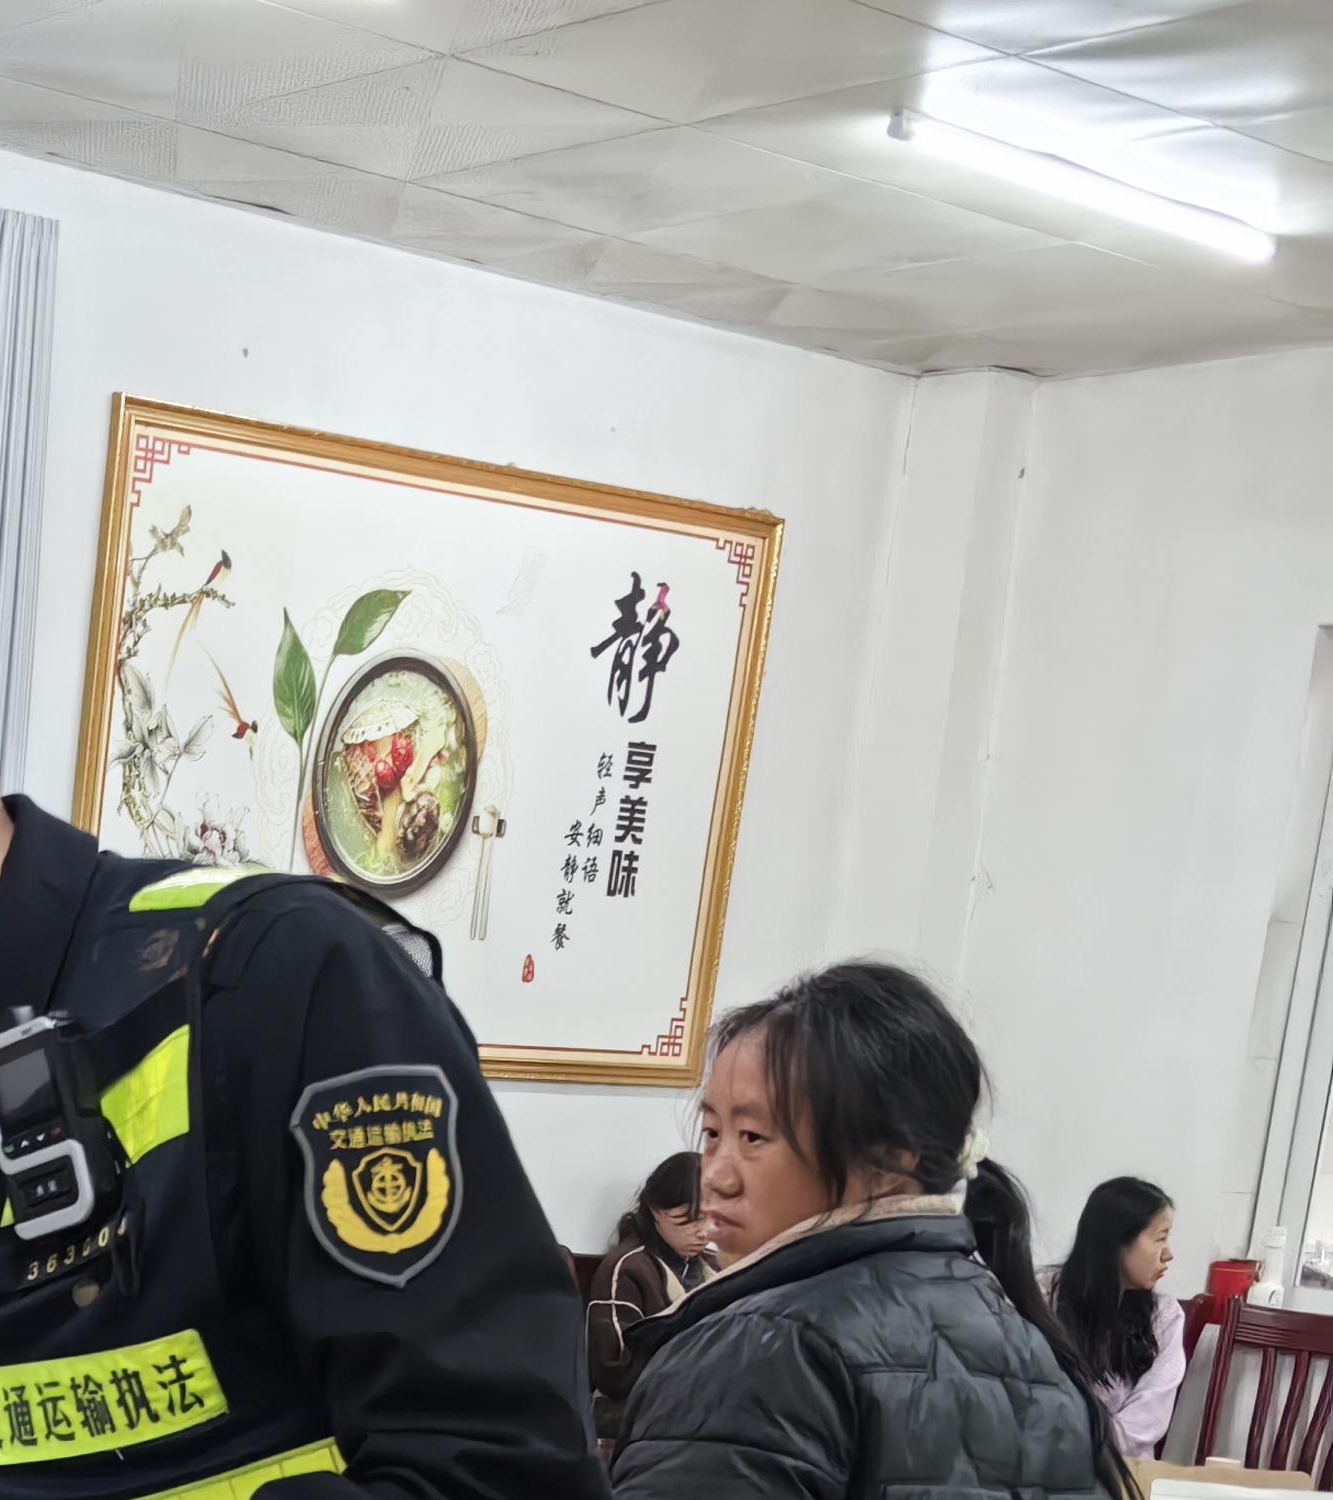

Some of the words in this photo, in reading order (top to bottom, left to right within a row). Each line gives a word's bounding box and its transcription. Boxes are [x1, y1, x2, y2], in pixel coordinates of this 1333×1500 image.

[590, 571, 680, 724] 静
[581, 752, 614, 883] 轻声细语
[606, 741, 657, 898] 享美味
[550, 819, 584, 951] 安静就餐
[312, 1090, 443, 1130] 中华人民共和国
[329, 1118, 434, 1150] 交通运输执法
